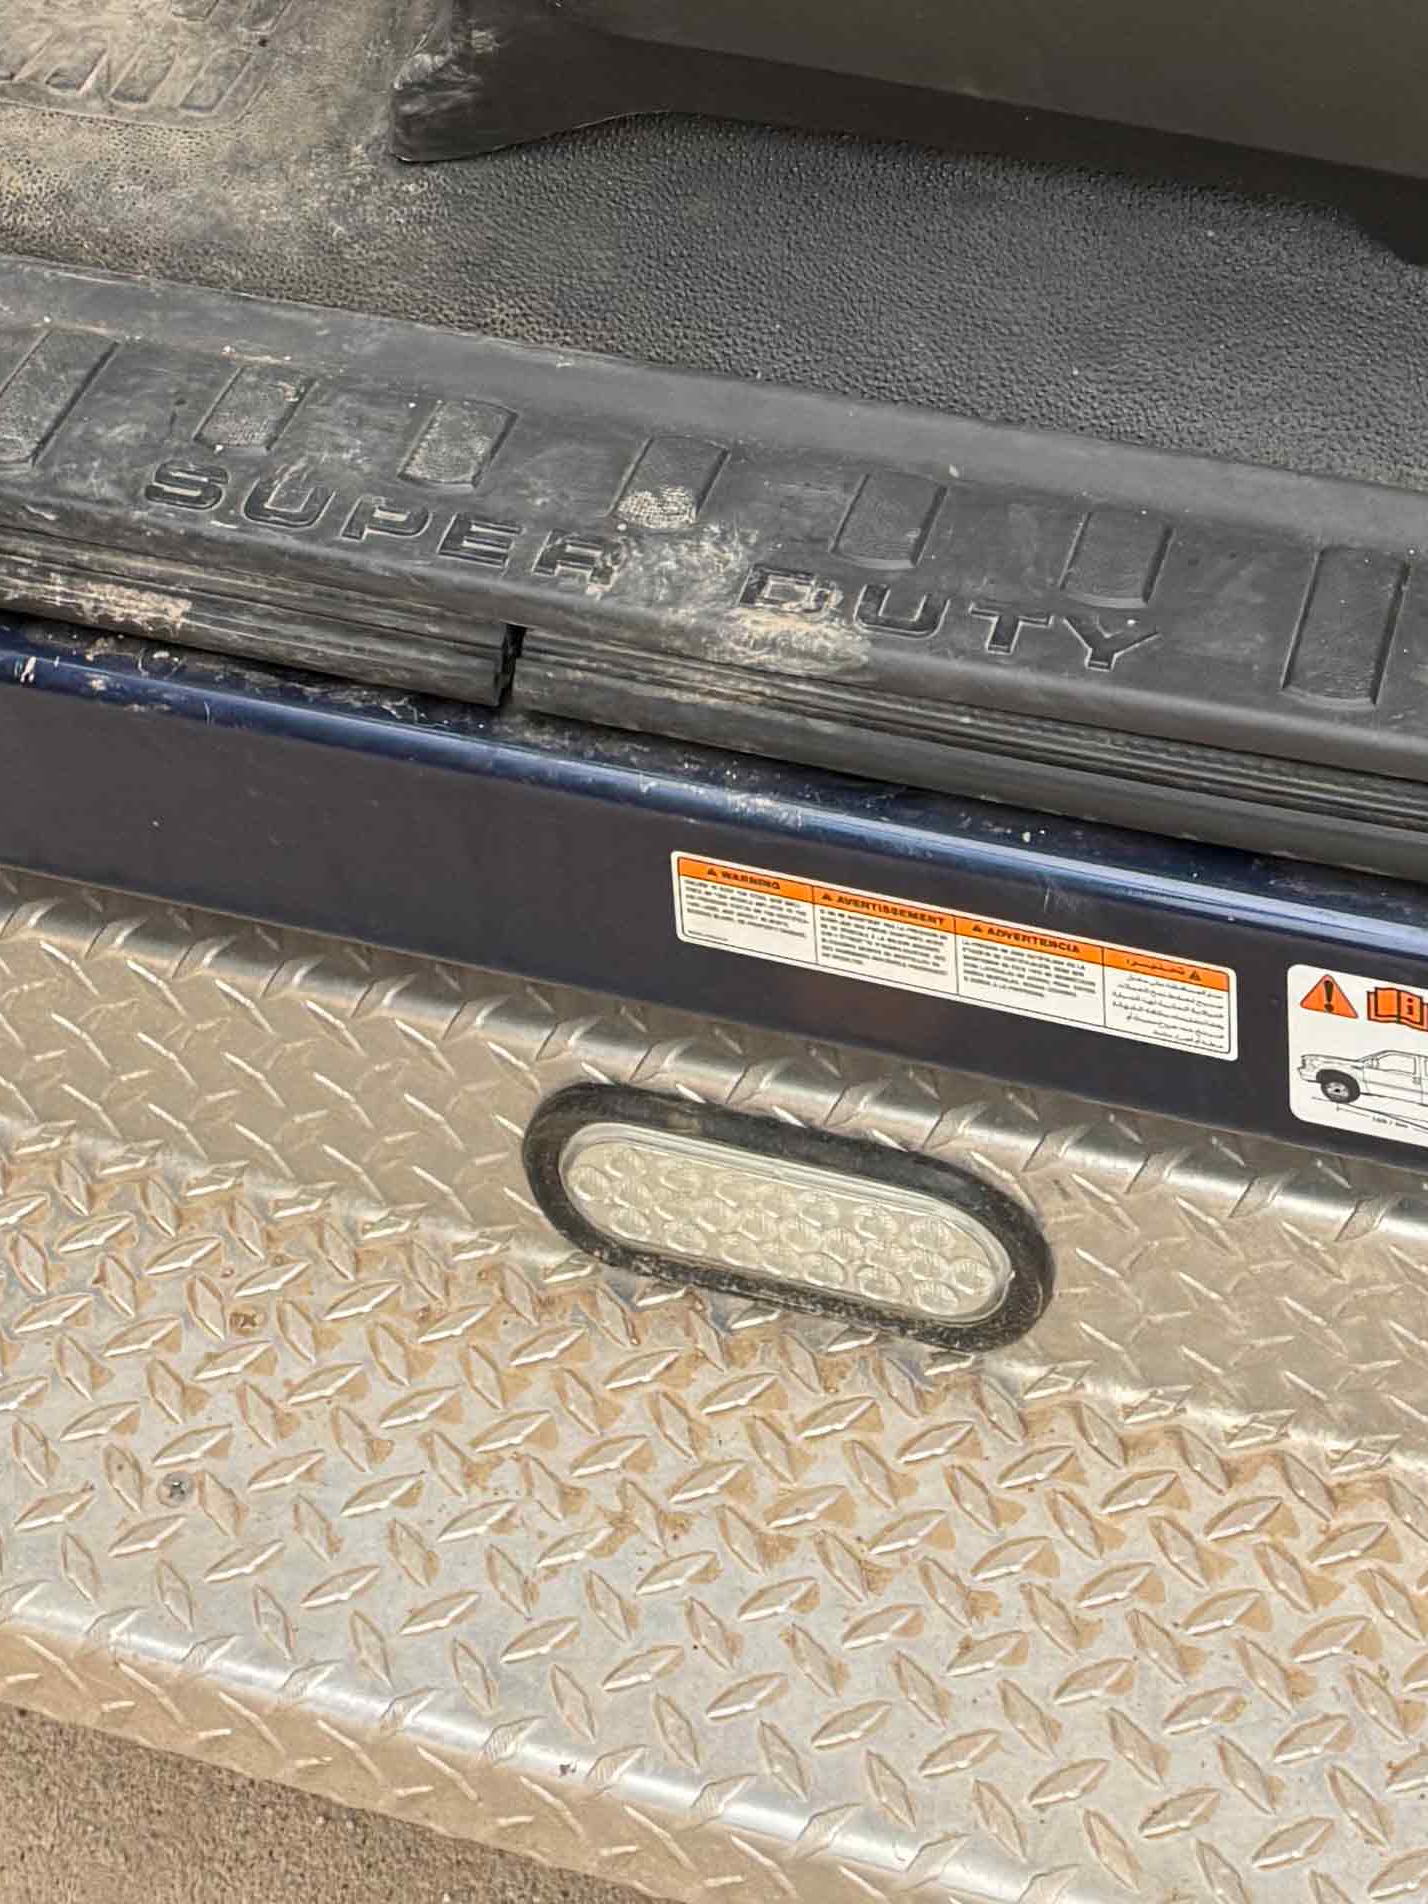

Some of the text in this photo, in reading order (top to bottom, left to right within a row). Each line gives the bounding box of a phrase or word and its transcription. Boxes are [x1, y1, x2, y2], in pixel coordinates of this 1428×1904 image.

[144, 459, 1160, 672] SUPER DUTY
[720, 871, 780, 890] WARNING
[837, 895, 944, 925] AVERTISSEMENT
[987, 927, 1081, 953] ADVERTENCIA
